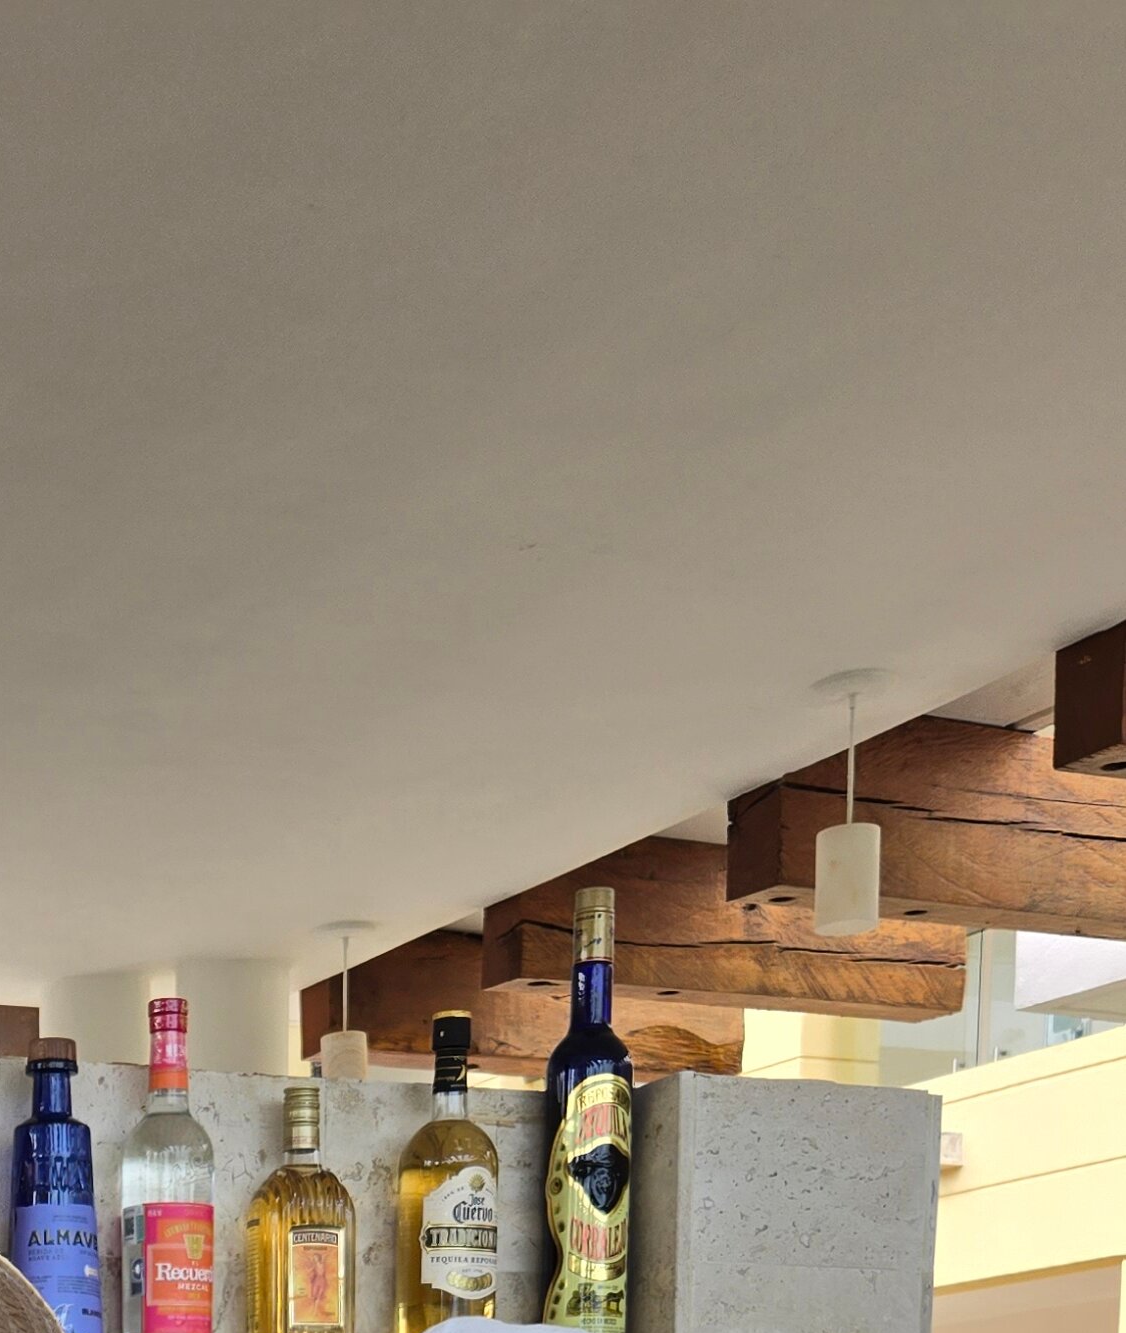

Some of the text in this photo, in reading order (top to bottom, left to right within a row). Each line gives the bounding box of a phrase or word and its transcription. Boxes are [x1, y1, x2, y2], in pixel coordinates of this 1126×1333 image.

[453, 1200, 493, 1224] Cuervo
[293, 1232, 337, 1244] CENTENARIO
[430, 1227, 496, 1249] TRADICION
[430, 1255, 469, 1265] TEQUILA
